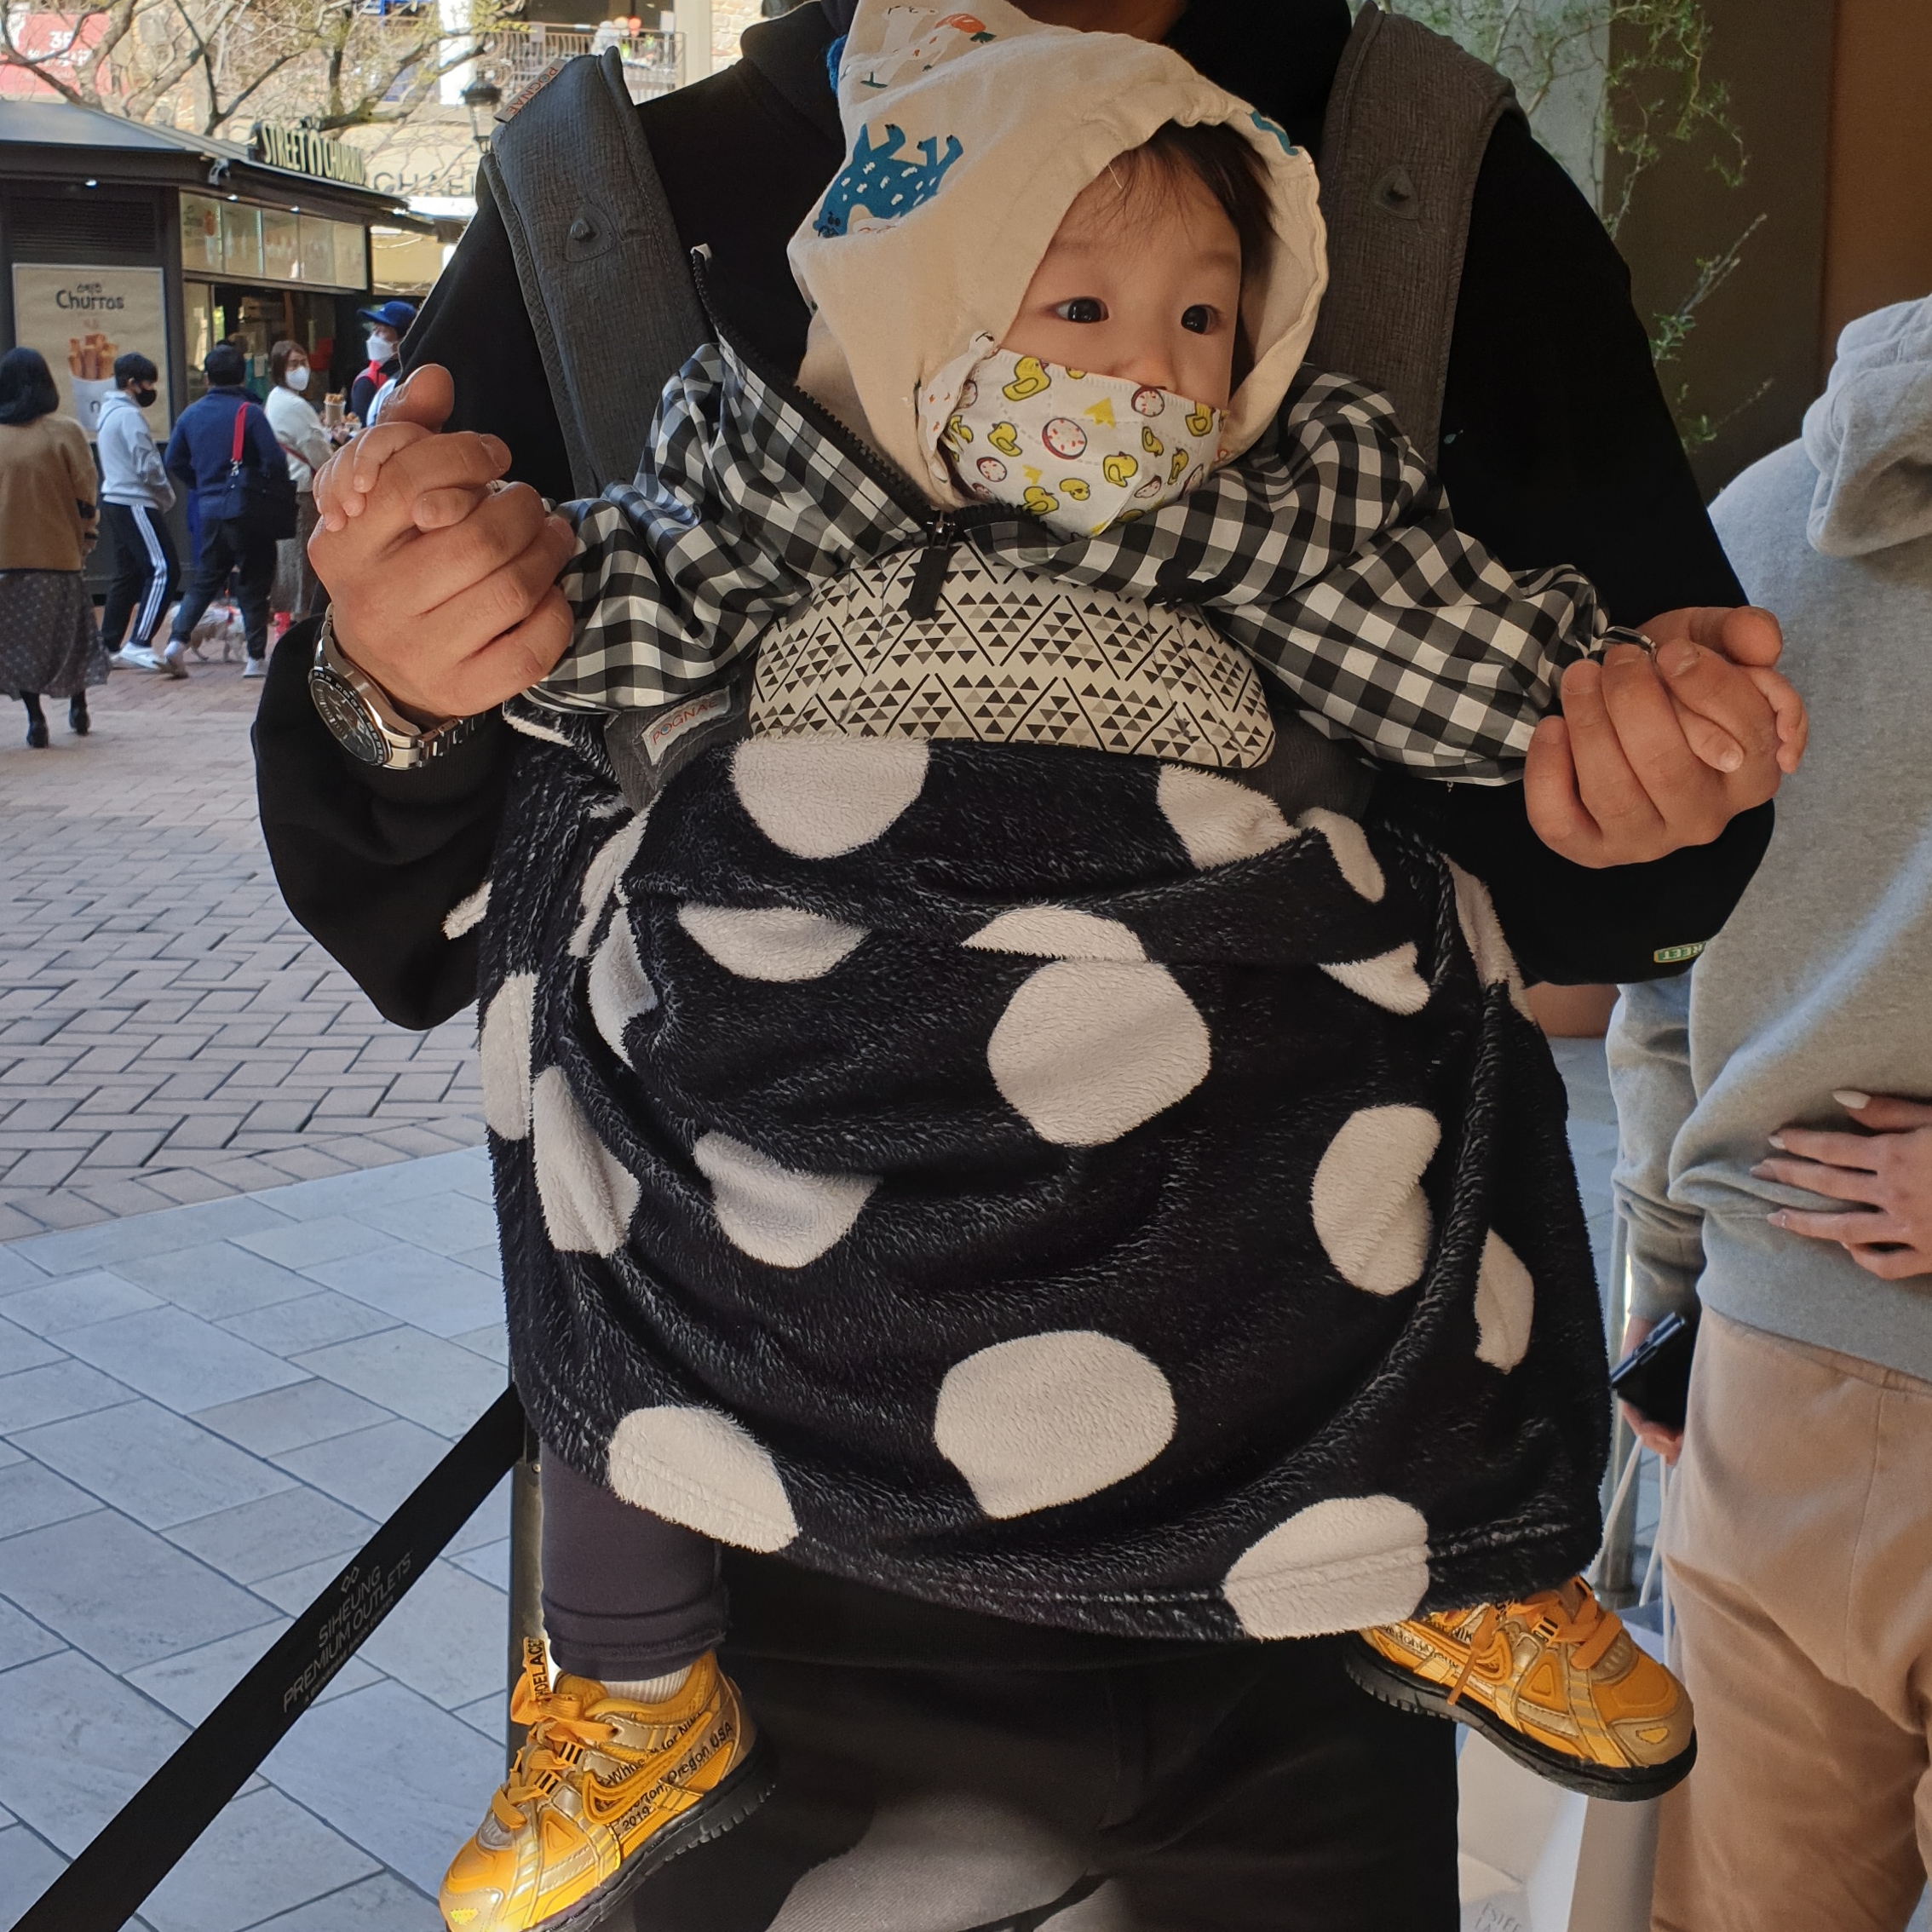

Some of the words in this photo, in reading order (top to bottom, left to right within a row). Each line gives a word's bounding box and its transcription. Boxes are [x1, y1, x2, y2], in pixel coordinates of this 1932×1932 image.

[506, 66, 558, 114] POGNAE
[262, 119, 307, 173] STREET
[55, 289, 125, 310] Churros
[653, 698, 718, 746] POGNAE
[319, 1565, 382, 1648] SIHEUNG
[283, 1621, 351, 1713] PREMIUM
[353, 1552, 412, 1631] OUTLETS
[667, 1745, 710, 1785] Oregon
[710, 1721, 733, 1748] USA
[622, 1804, 653, 1831] 2019
